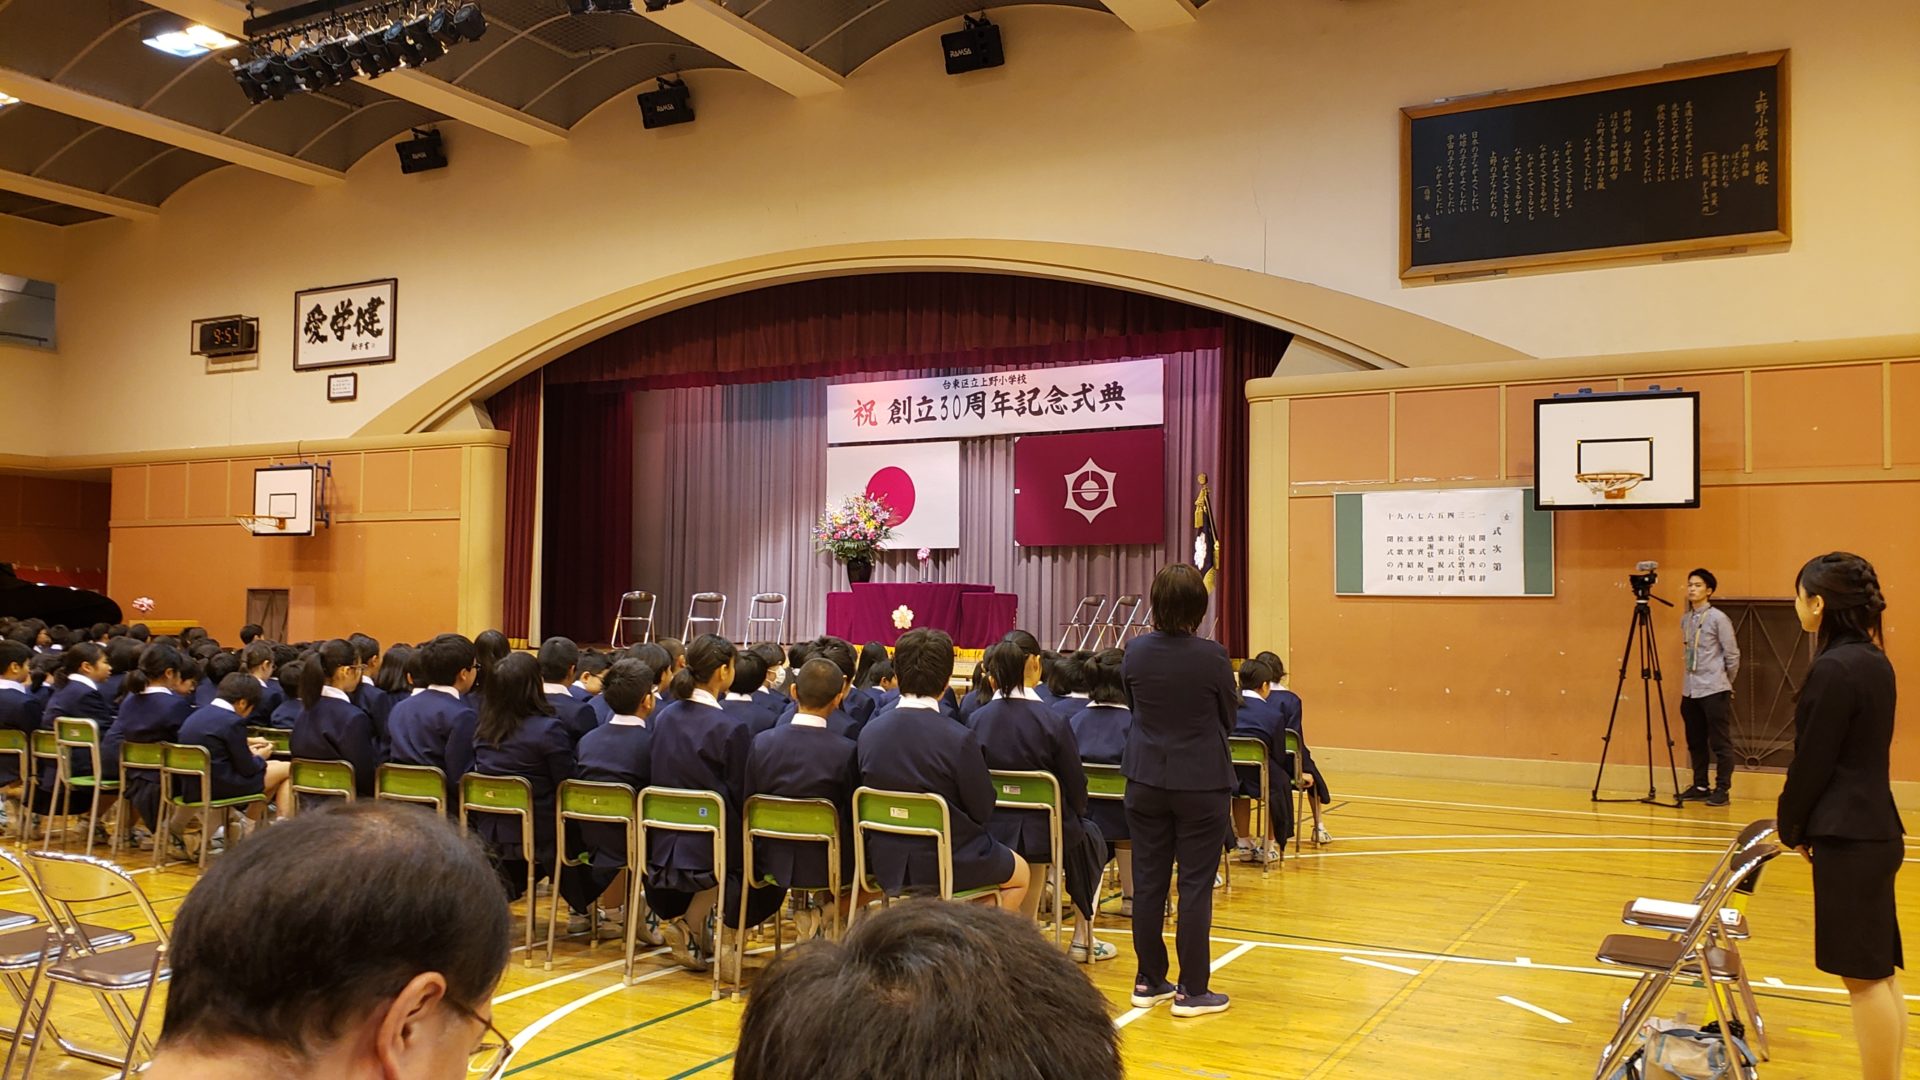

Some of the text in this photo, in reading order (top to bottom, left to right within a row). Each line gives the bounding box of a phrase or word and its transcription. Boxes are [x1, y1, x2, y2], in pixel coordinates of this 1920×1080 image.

[1754, 91, 1769, 185] 上野小学校 校歌
[852, 381, 1126, 427] 祝 創立30周年記念式典
[941, 373, 1028, 390] 台東区立上野小学校
[1493, 526, 1502, 571] 式次第
